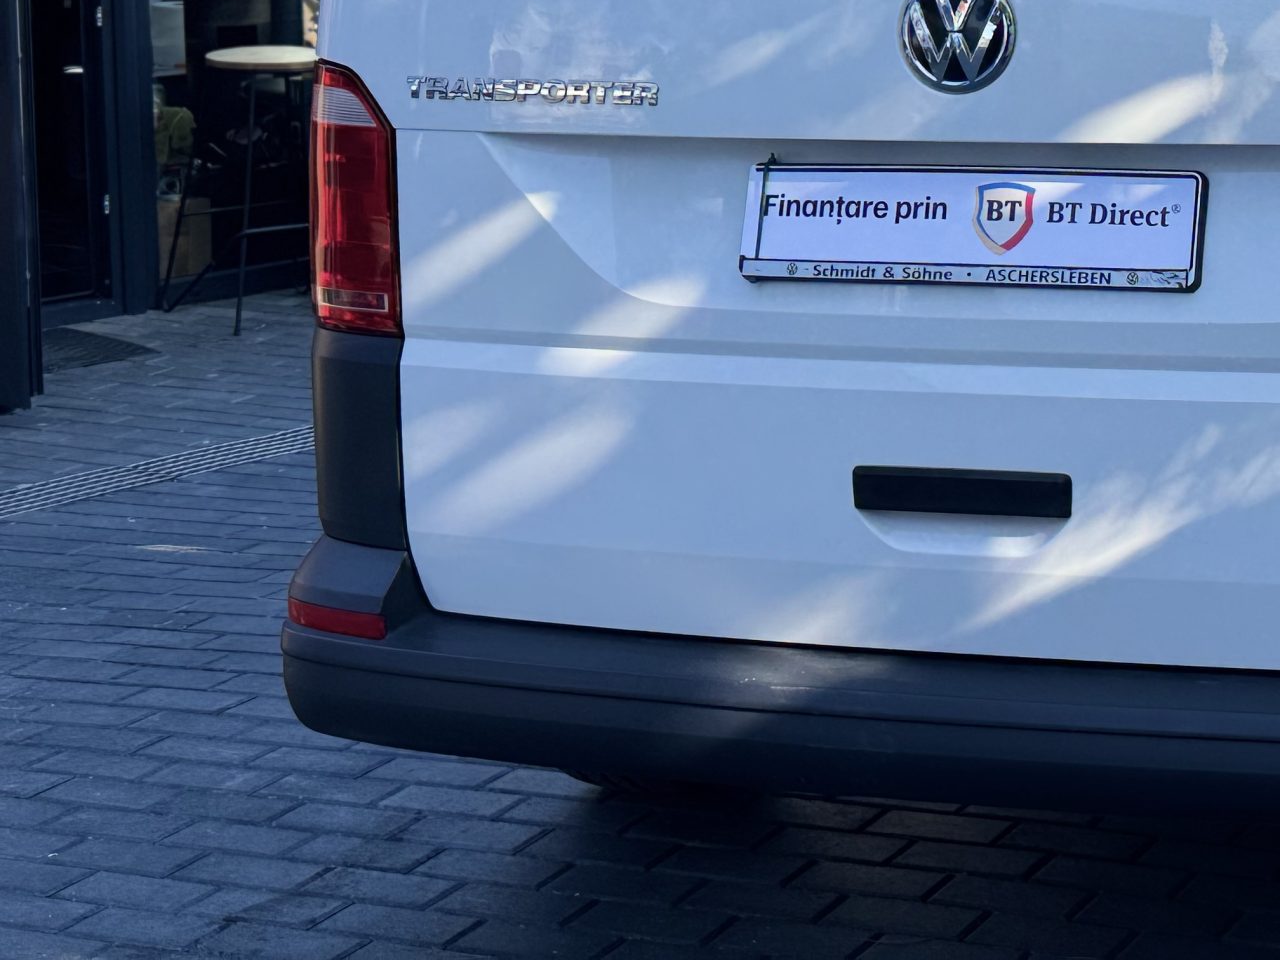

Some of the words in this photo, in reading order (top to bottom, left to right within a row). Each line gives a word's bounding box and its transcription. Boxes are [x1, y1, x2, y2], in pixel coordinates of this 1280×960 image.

[406, 75, 660, 106] TRANSPORTER
[763, 193, 889, 225] Finanțare
[894, 196, 948, 224] prin
[986, 199, 1022, 222] BT
[1046, 201, 1083, 224] BT
[813, 264, 876, 279] Schmidt
[882, 267, 895, 279] &
[902, 266, 953, 280] Söhne
[985, 269, 1112, 285] ASCHERSLEBEN
